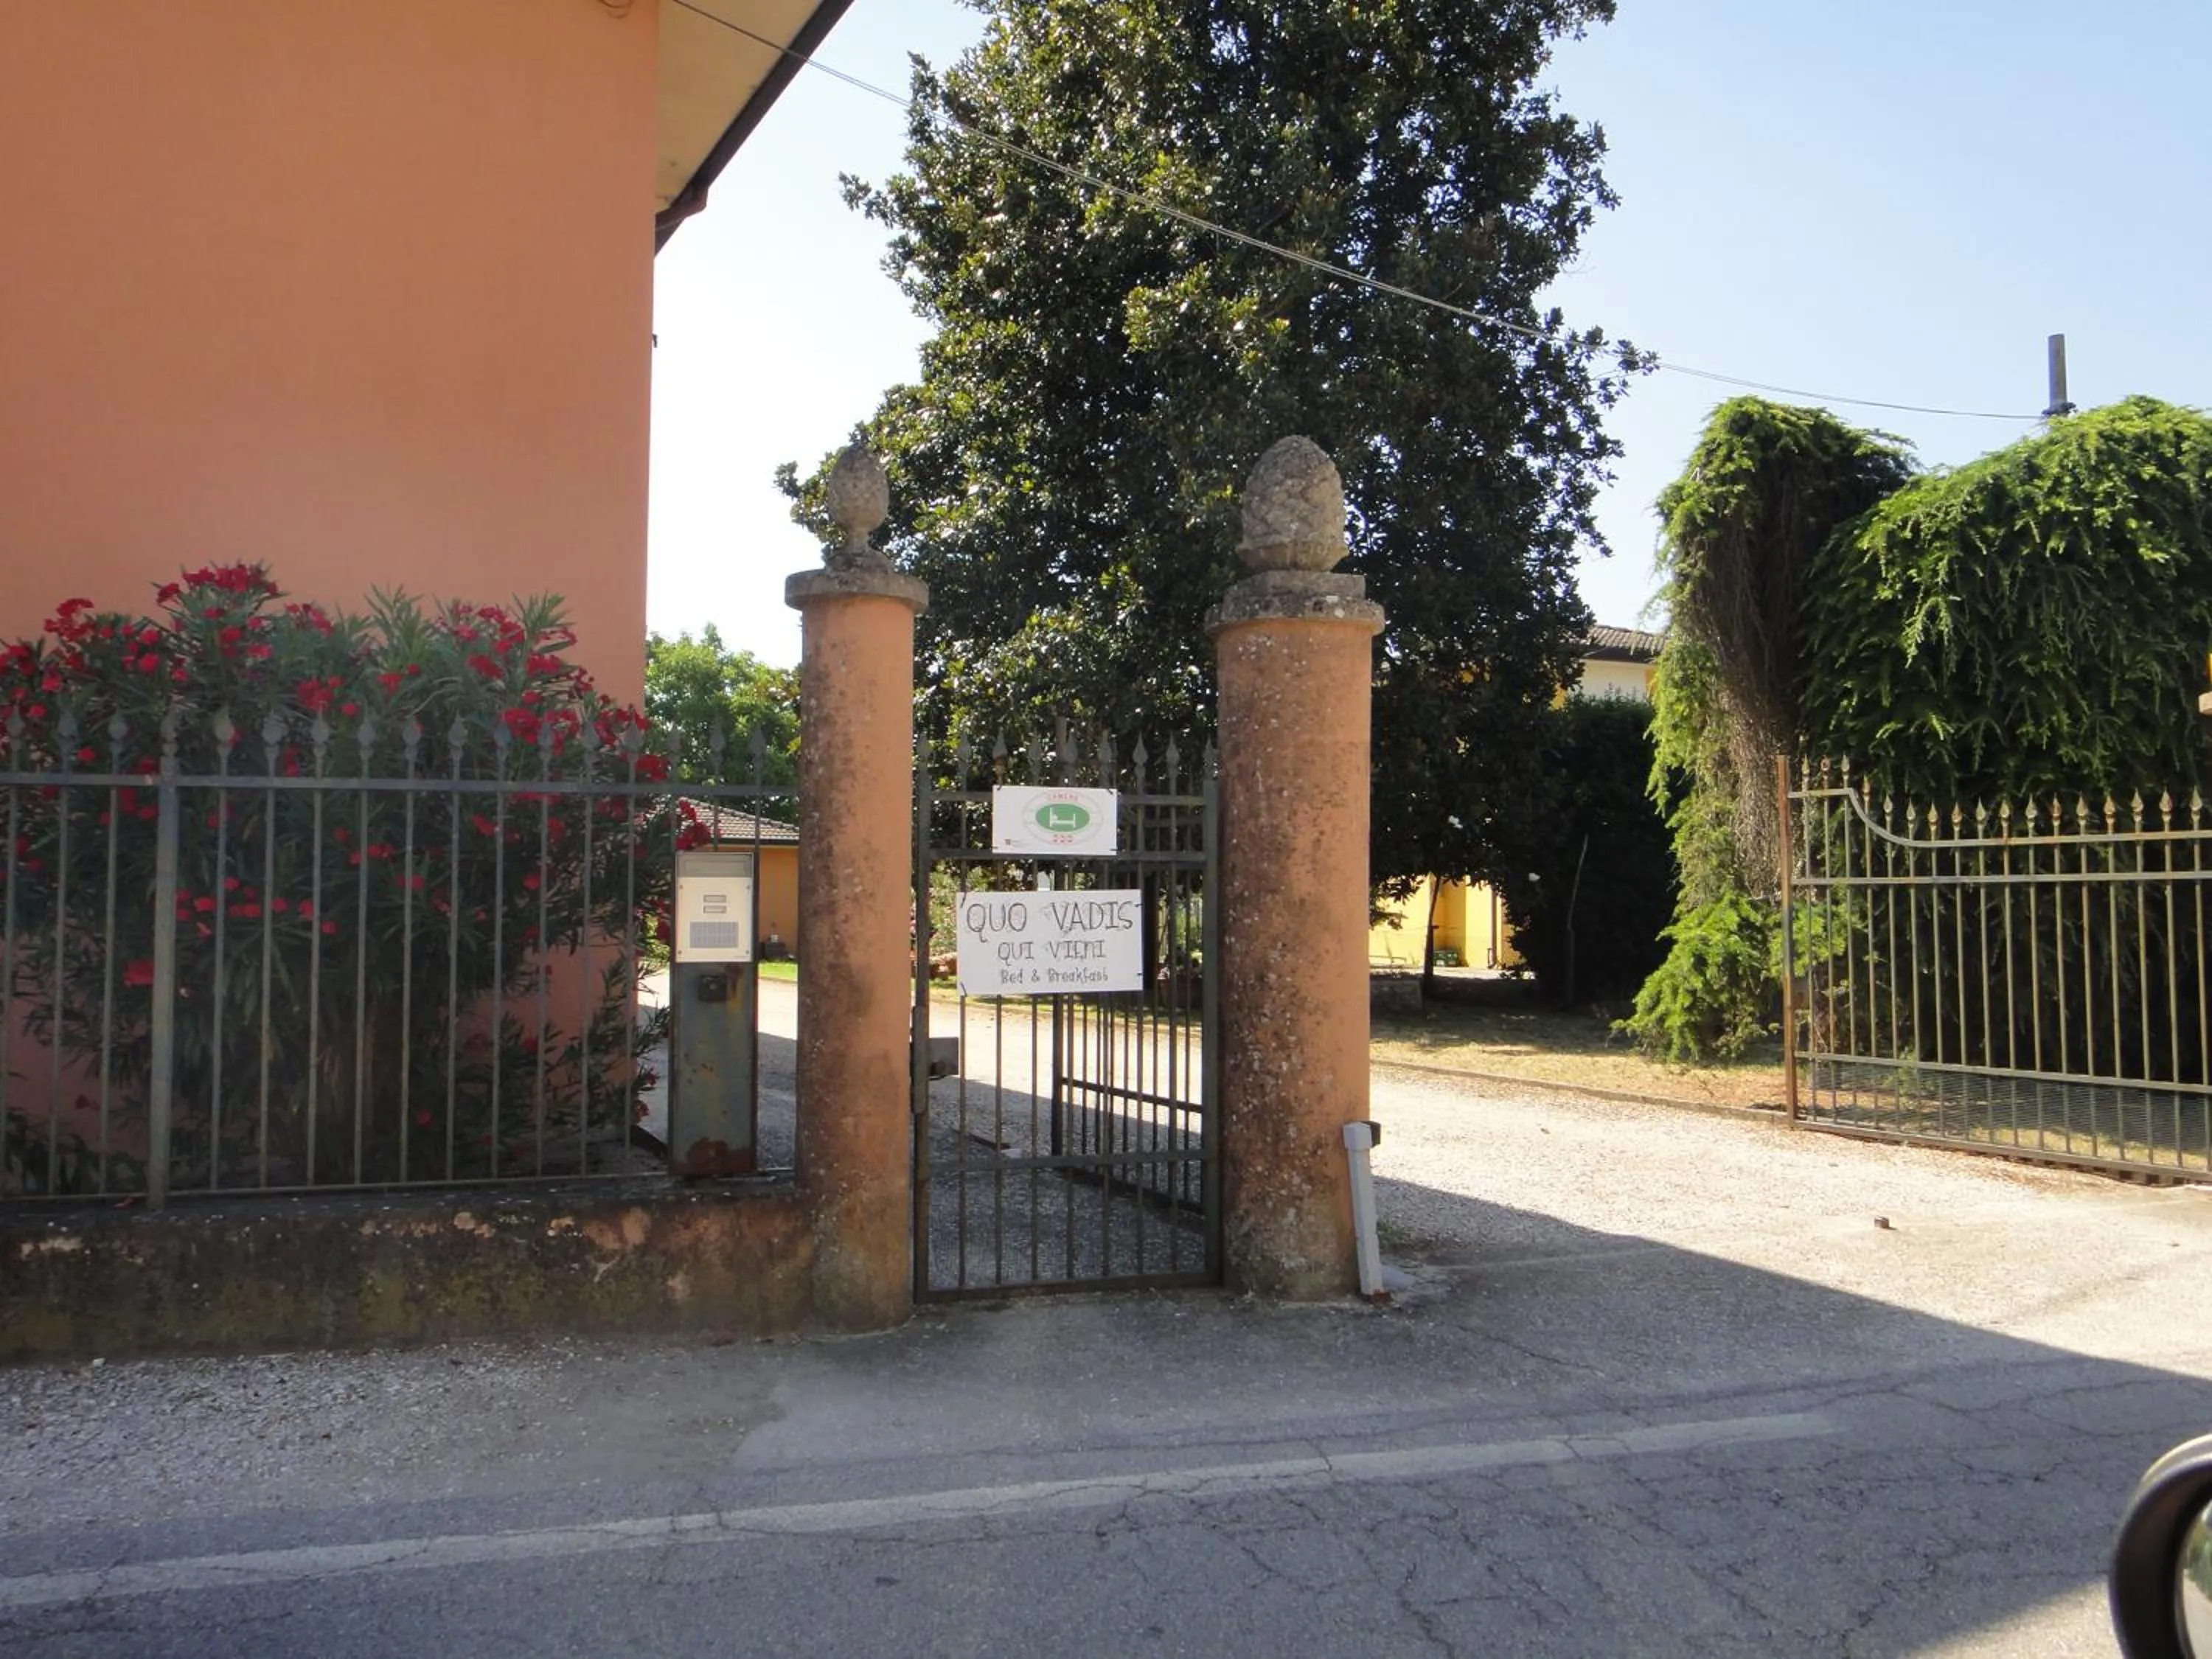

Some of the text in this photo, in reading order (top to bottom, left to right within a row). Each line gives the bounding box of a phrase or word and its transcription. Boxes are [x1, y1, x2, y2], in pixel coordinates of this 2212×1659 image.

[967, 900, 1133, 942] QUO VADIS
[998, 941, 1034, 966] QUI
[1001, 967, 1108, 984] Bed & Breakfast
